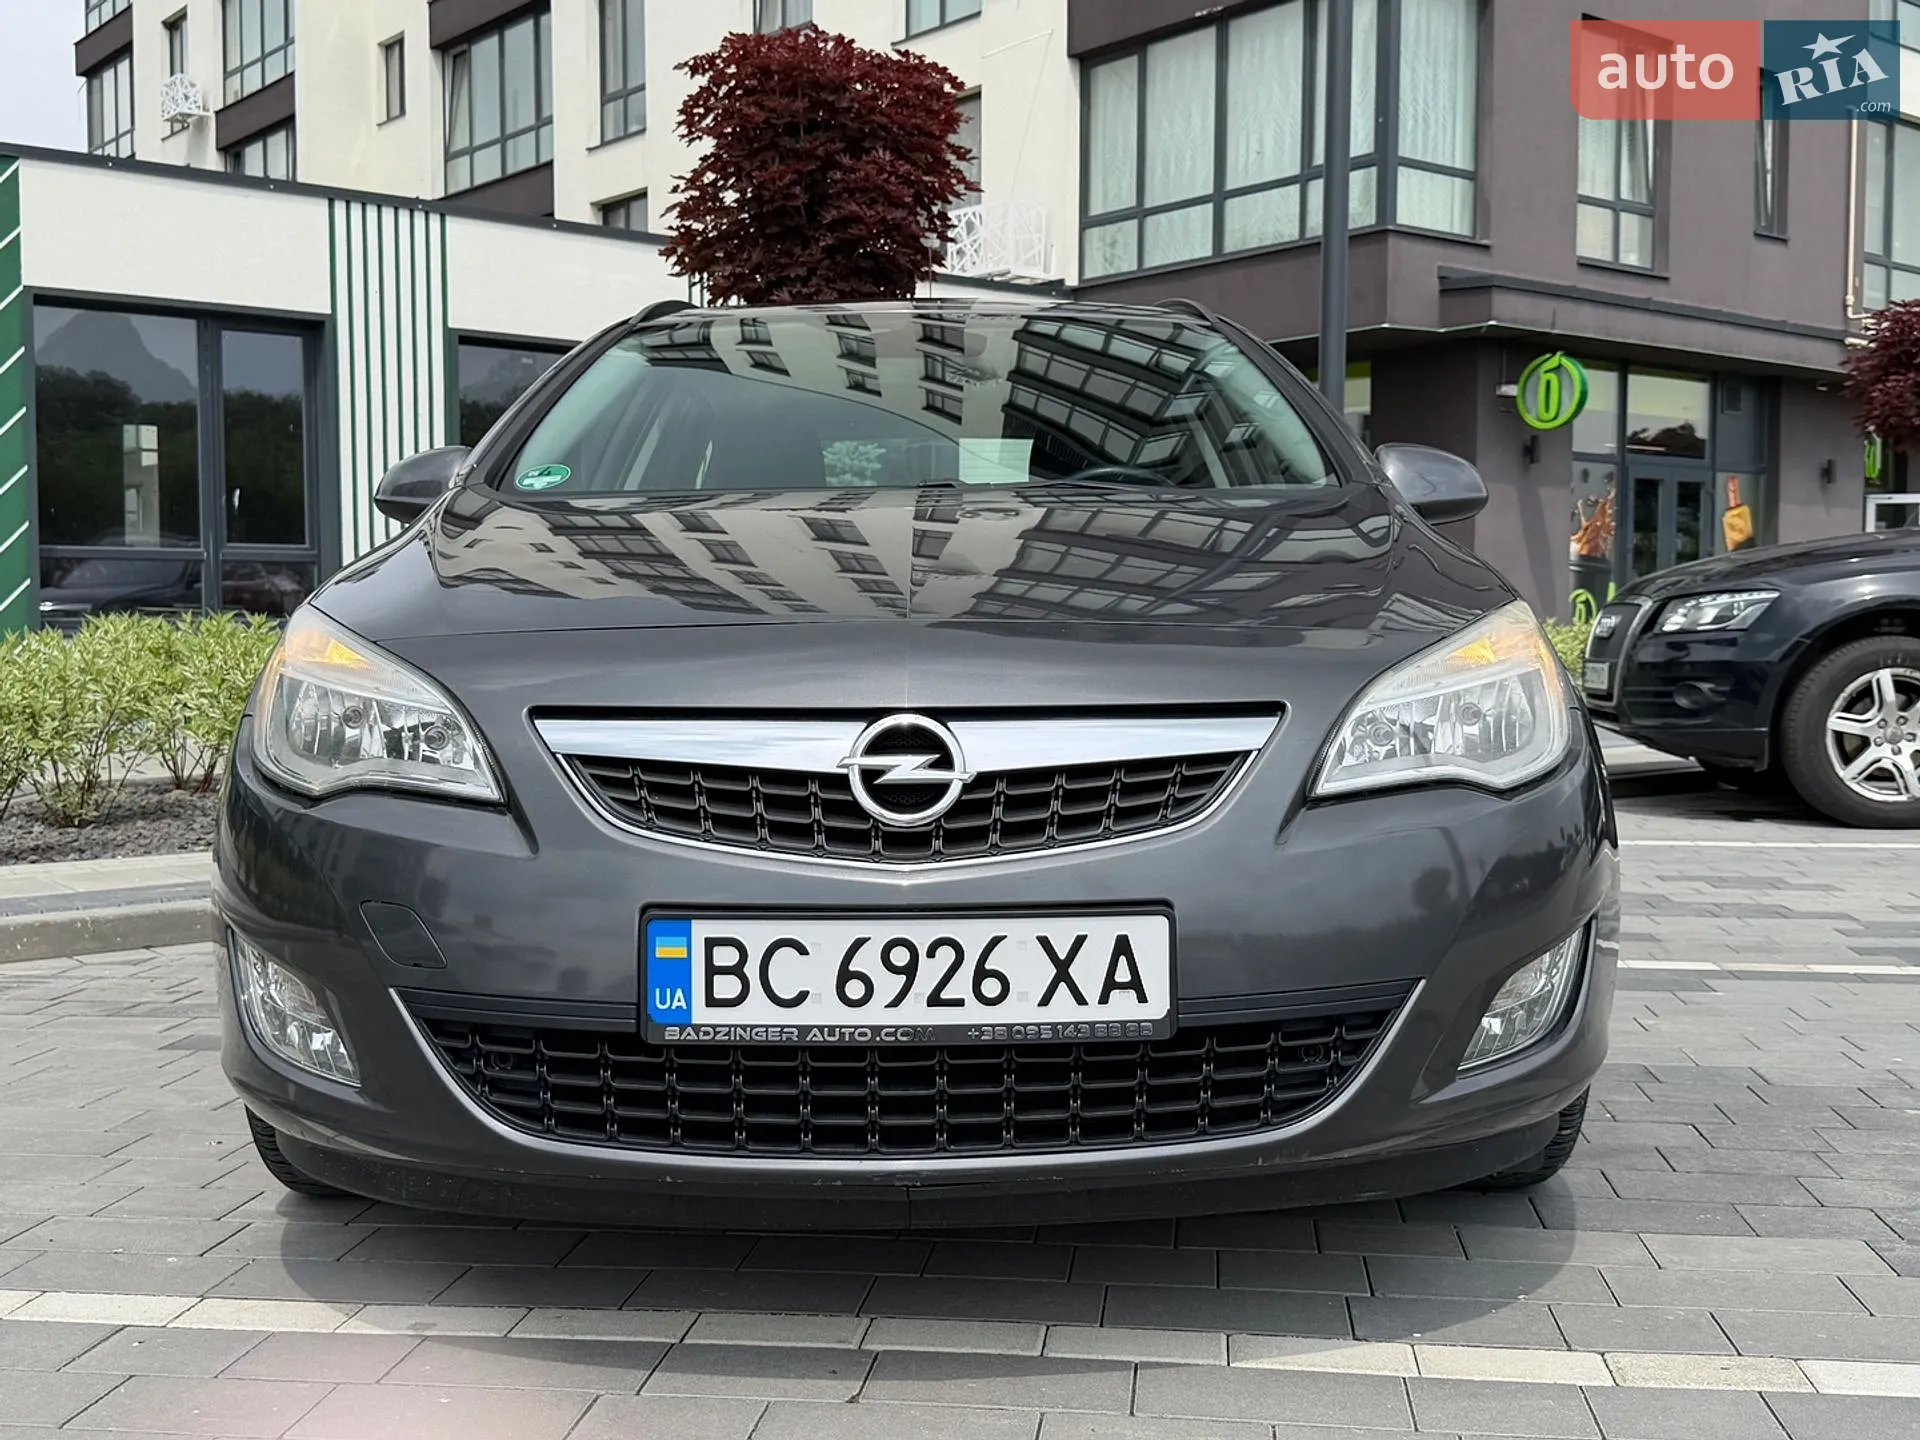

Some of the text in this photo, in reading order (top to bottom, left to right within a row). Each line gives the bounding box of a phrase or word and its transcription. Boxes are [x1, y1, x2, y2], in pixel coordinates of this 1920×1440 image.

[704, 933, 1149, 1009] BC 6926 XA
[655, 987, 687, 1010] UA
[664, 1026, 799, 1041] BADZINGER
